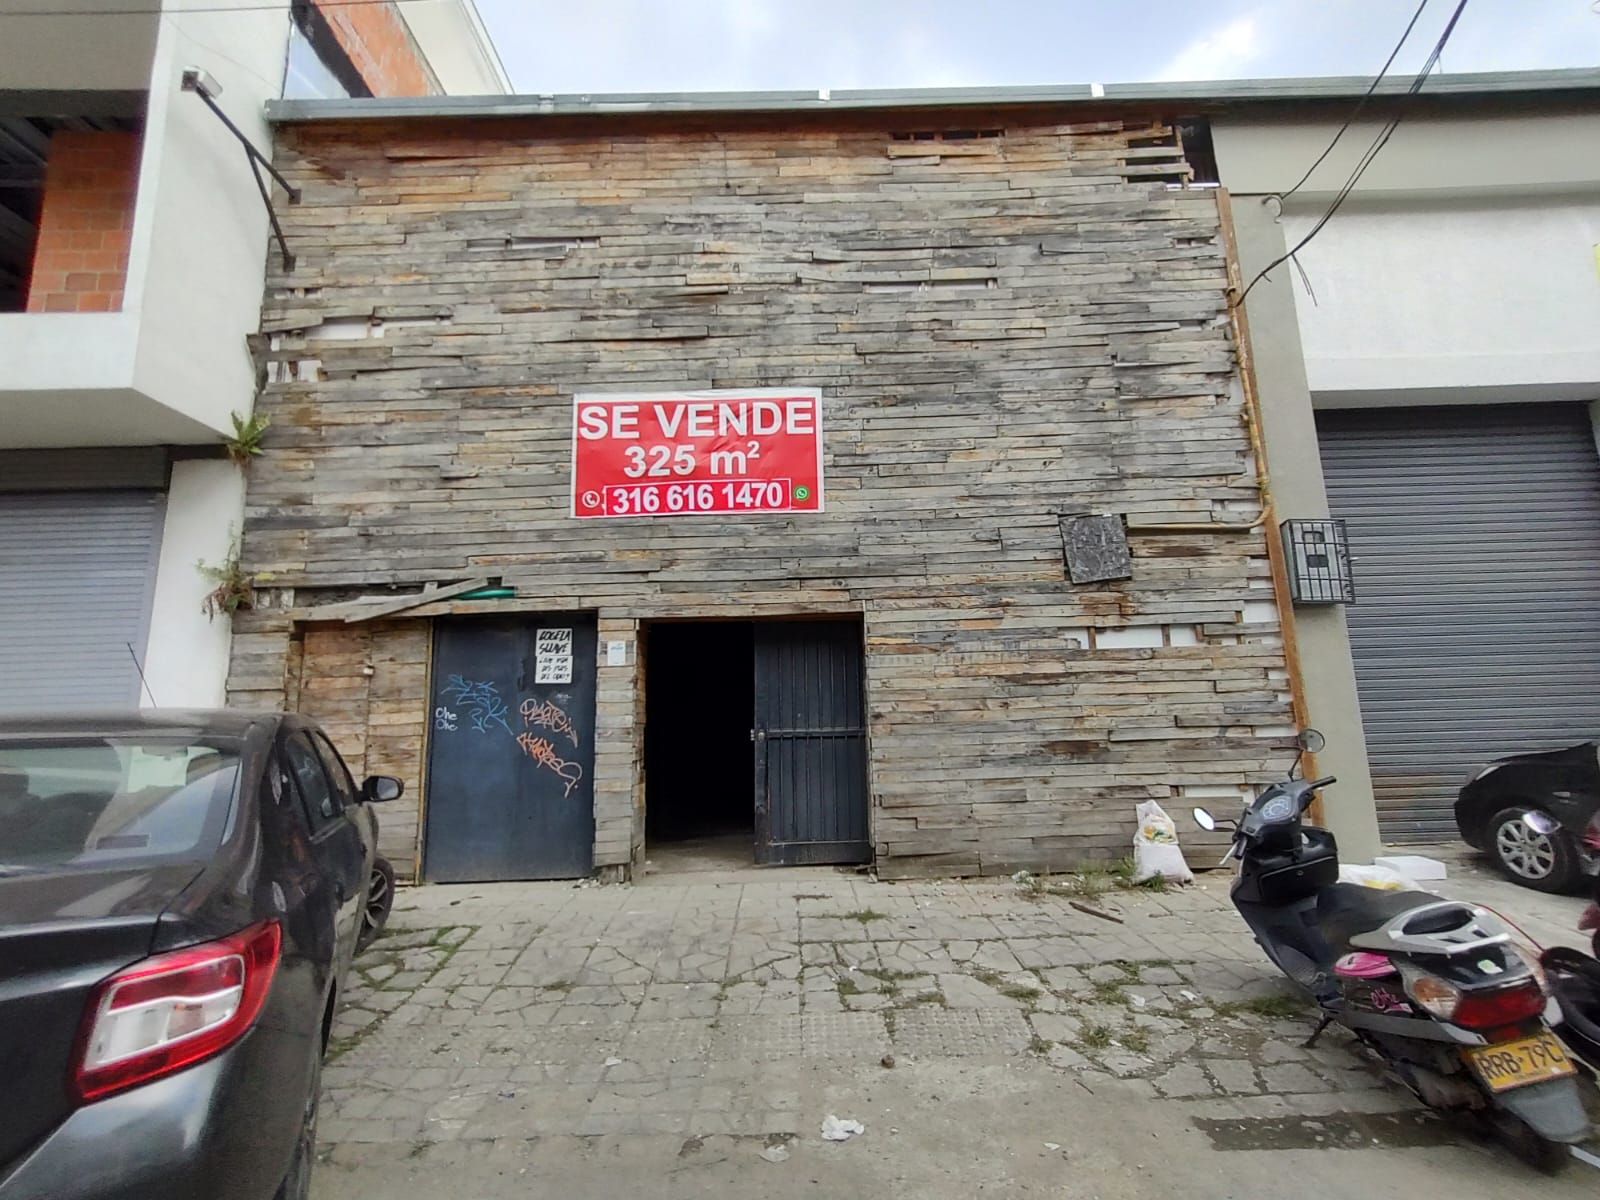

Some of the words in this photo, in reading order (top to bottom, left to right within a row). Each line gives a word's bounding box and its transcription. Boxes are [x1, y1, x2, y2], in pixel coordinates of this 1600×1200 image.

[579, 405, 640, 440] SE
[654, 401, 814, 438] VENDE
[623, 445, 696, 478] 325
[612, 488, 659, 514] 316
[666, 484, 714, 510] 616
[721, 482, 782, 509] 1470
